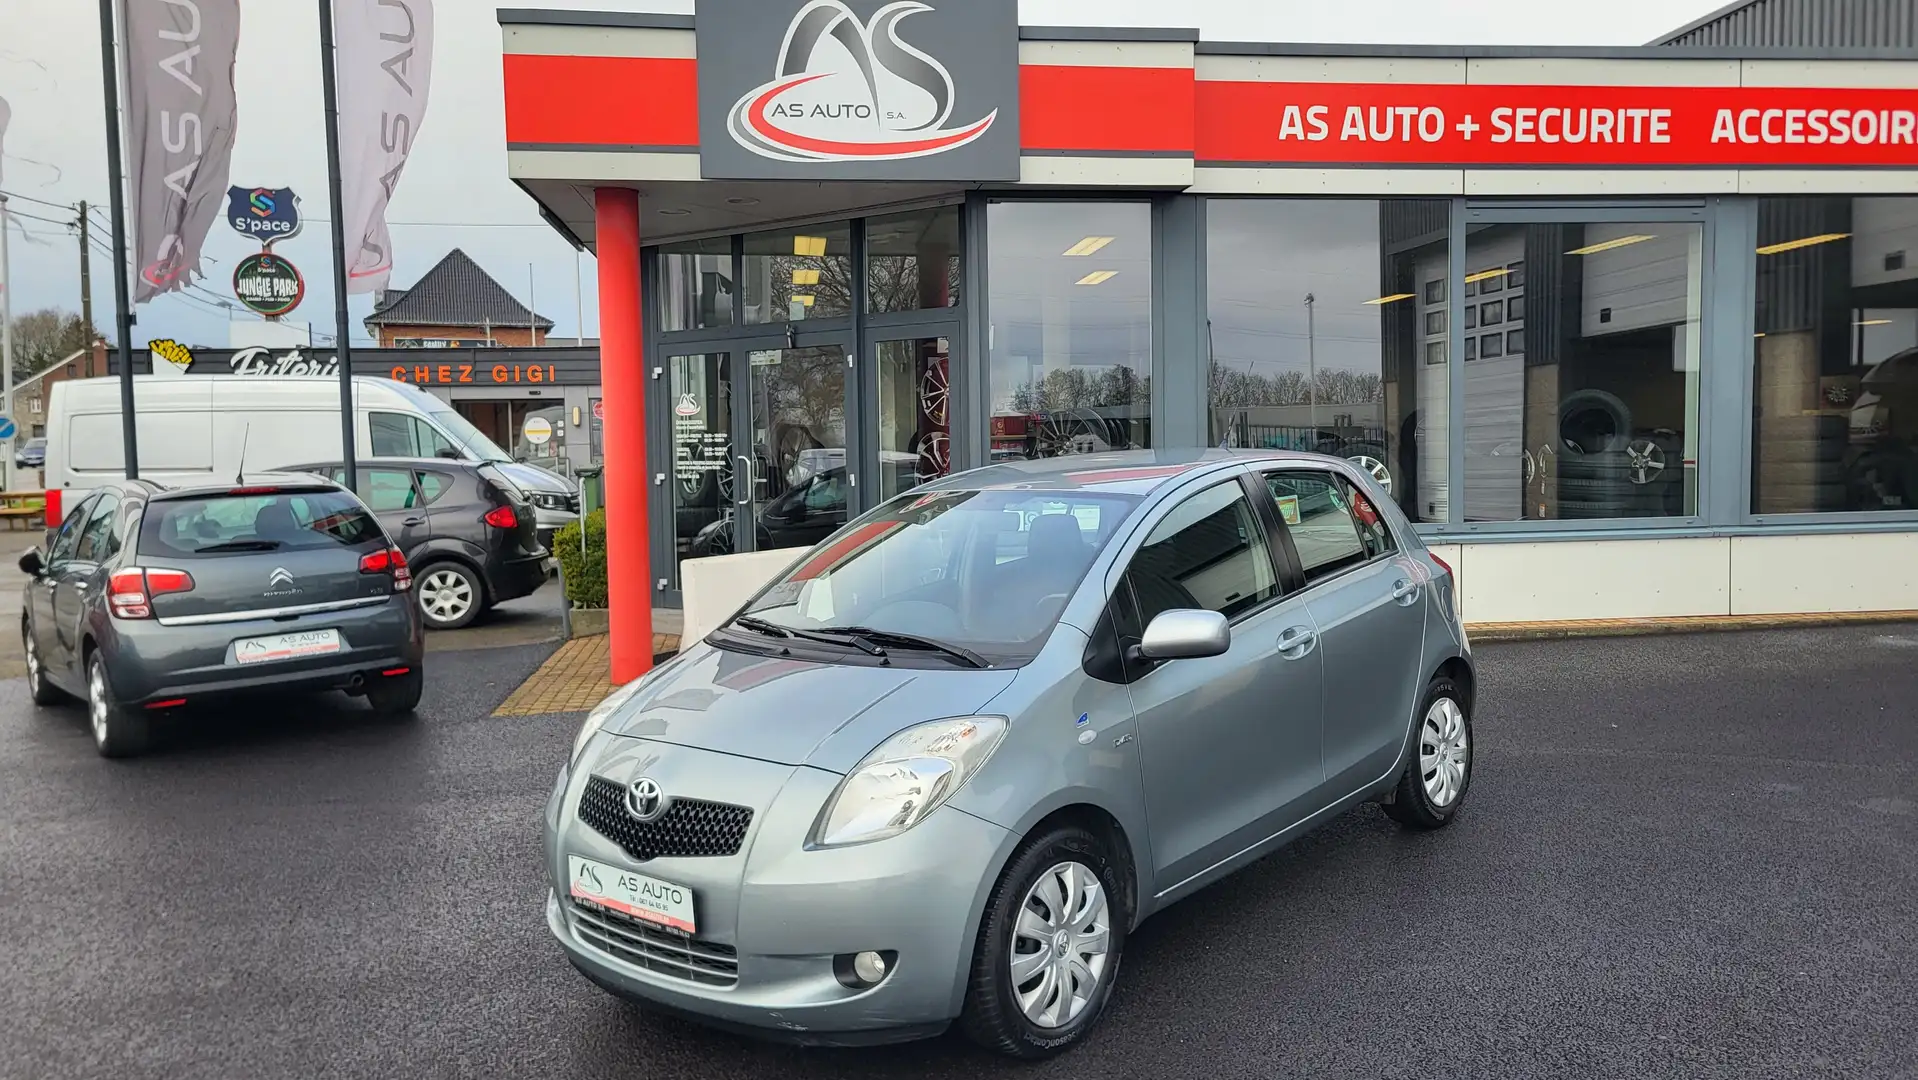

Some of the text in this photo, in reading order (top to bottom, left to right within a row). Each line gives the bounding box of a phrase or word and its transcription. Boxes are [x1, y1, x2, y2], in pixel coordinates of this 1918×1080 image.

[771, 104, 907, 119] AS AUTO S.A.
[1278, 105, 1672, 144] AS AUTO + SECURITE
[160, 111, 203, 200] AS
[379, 110, 411, 203] AS
[235, 217, 291, 232] S'pace
[237, 276, 298, 298] JUNGLE PARK
[391, 364, 556, 383] CHEZ GIGI
[280, 634, 296, 644] AS
[300, 631, 330, 642] AUTO
[618, 874, 683, 905] AS AUTO
